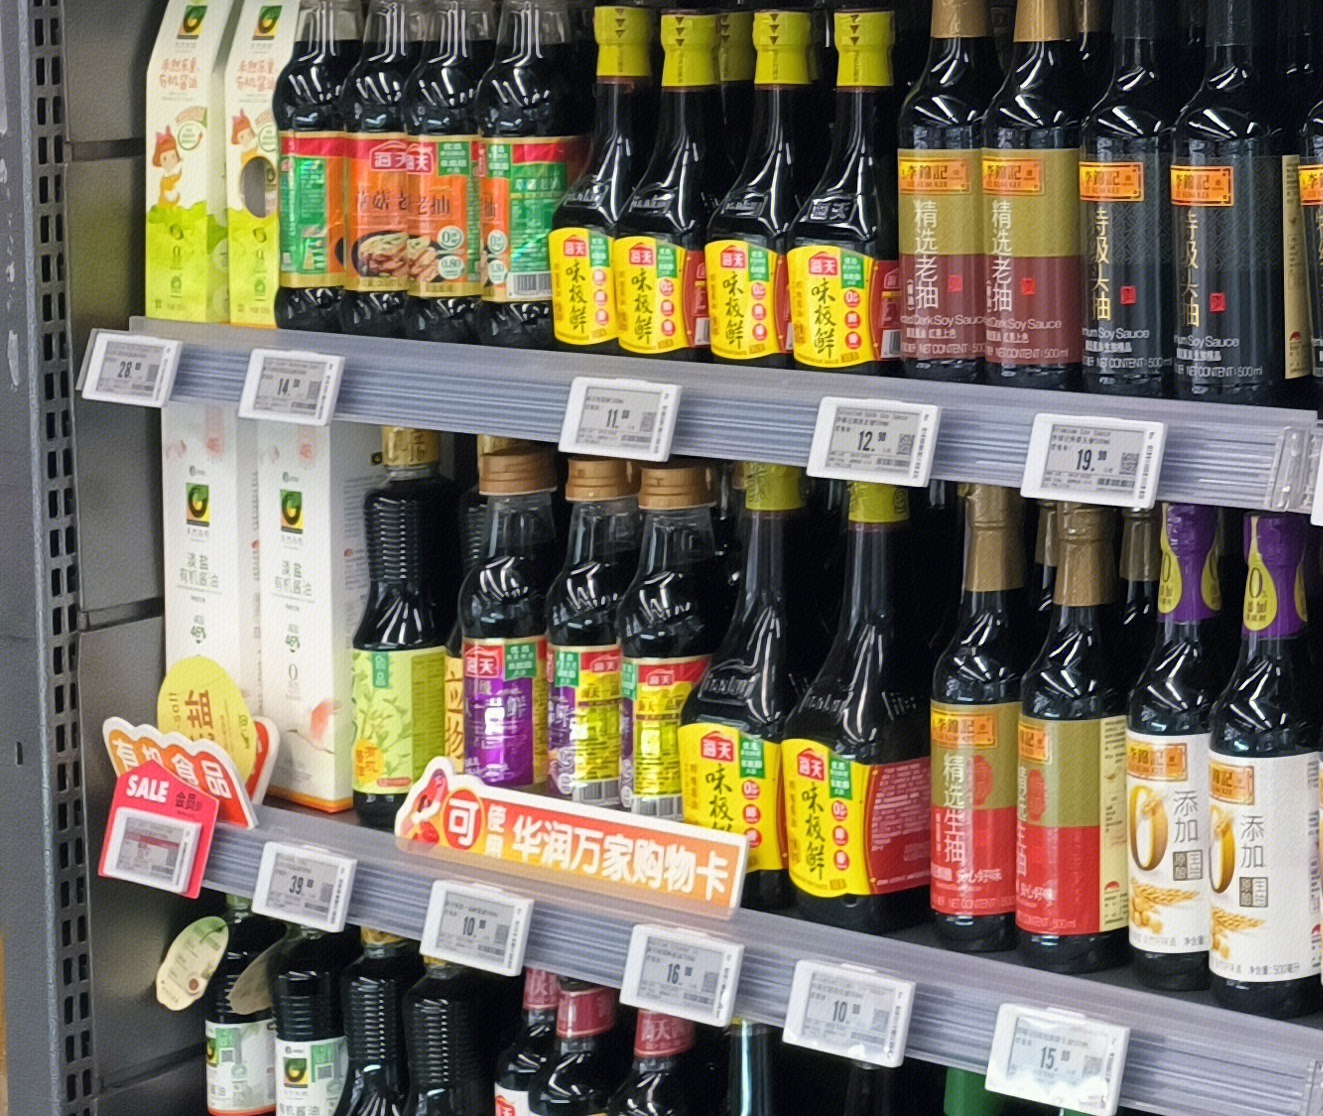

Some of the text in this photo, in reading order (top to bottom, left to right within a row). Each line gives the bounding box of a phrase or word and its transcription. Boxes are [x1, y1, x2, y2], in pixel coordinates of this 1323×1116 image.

[810, 256, 837, 275] 海天
[913, 200, 940, 311] 精选老抽
[991, 199, 1013, 314] 精选老抽
[702, 739, 735, 761] 海天
[799, 758, 824, 780] 海天
[126, 775, 170, 803] SALE
[943, 753, 967, 865] 精选生抽
[1173, 790, 1199, 845] 添加
[1239, 814, 1268, 870] 添加
[449, 798, 480, 847] 可
[512, 814, 730, 901] 华润万家购物卡
